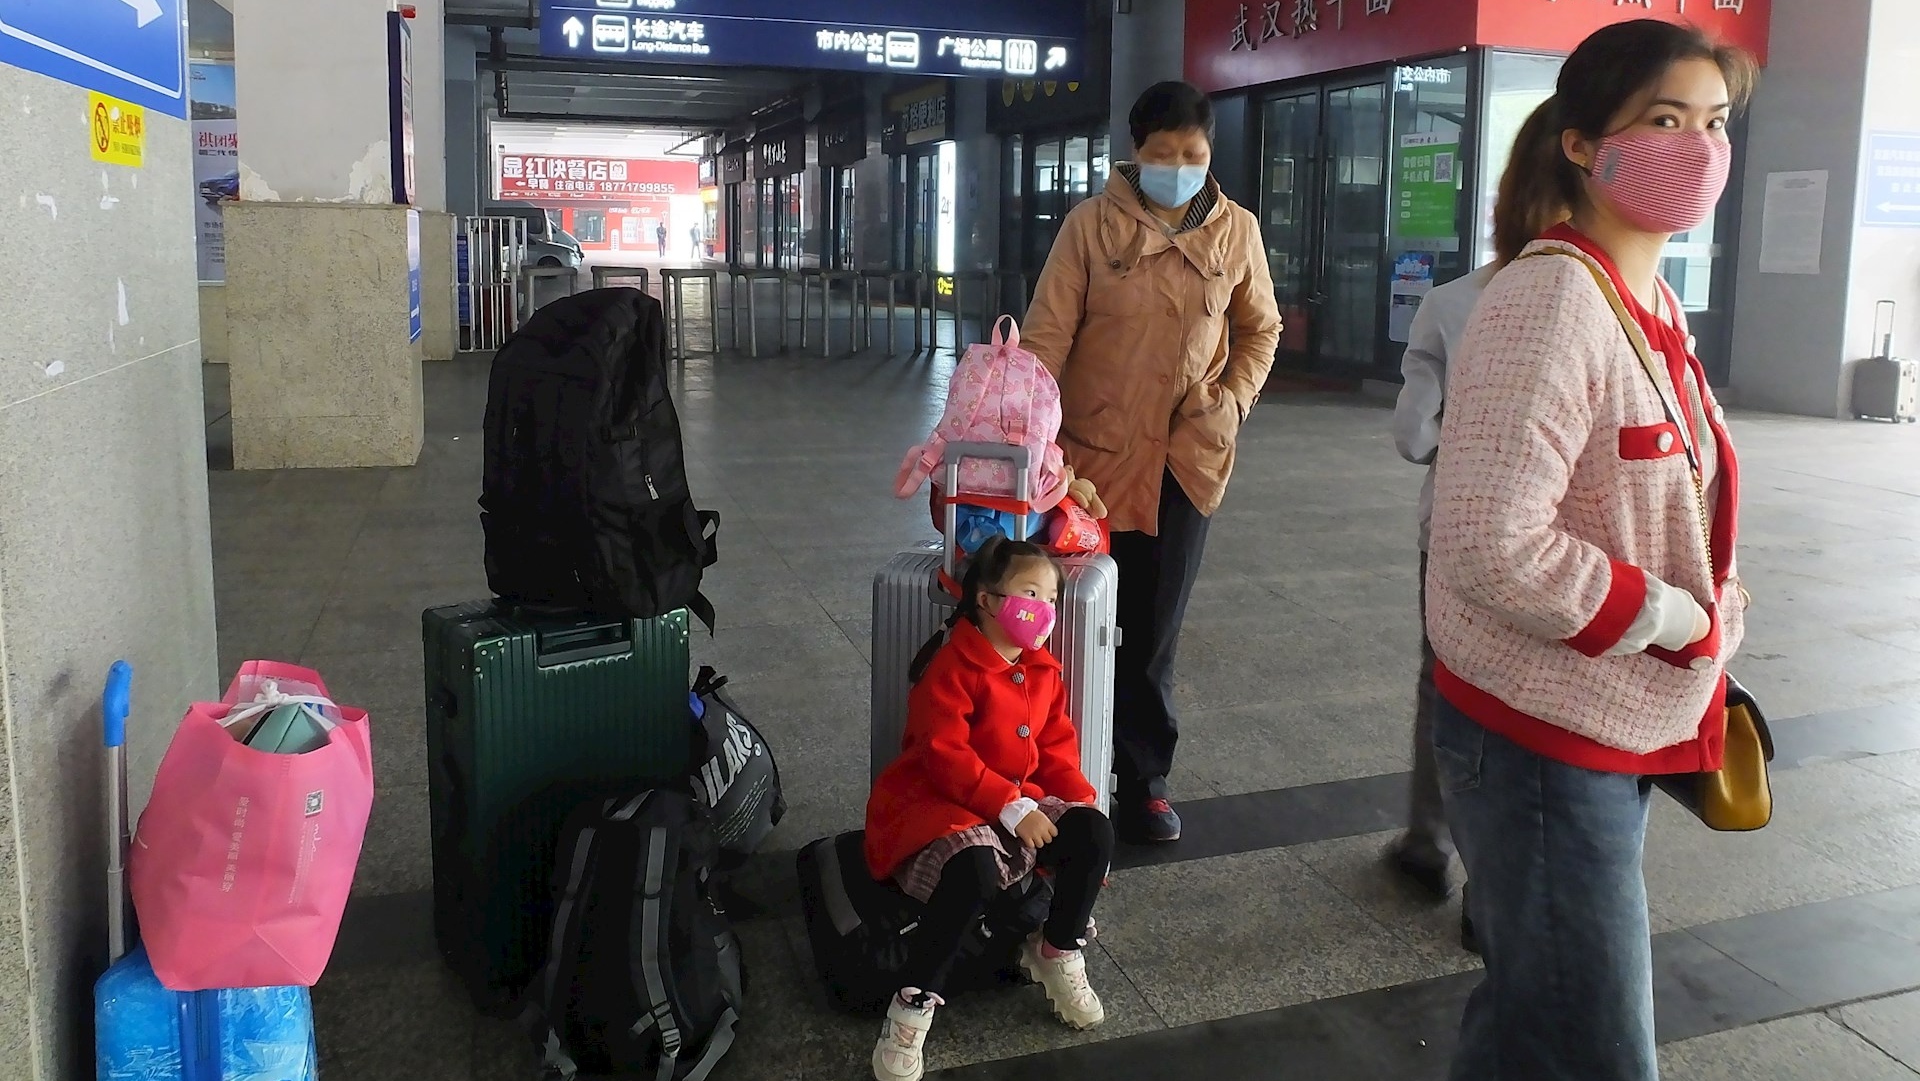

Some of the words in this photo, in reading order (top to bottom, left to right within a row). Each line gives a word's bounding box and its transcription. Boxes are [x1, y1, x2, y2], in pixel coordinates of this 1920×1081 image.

[632, 18, 705, 41] 长途汽车
[632, 40, 691, 53] Long-Distance
[692, 42, 710, 54] Bus
[816, 29, 884, 52] 市内公交
[866, 52, 884, 63] Bus
[503, 157, 607, 181] 显红快餐店
[554, 180, 595, 192] 住宿电话
[599, 181, 675, 194] 18771799855
